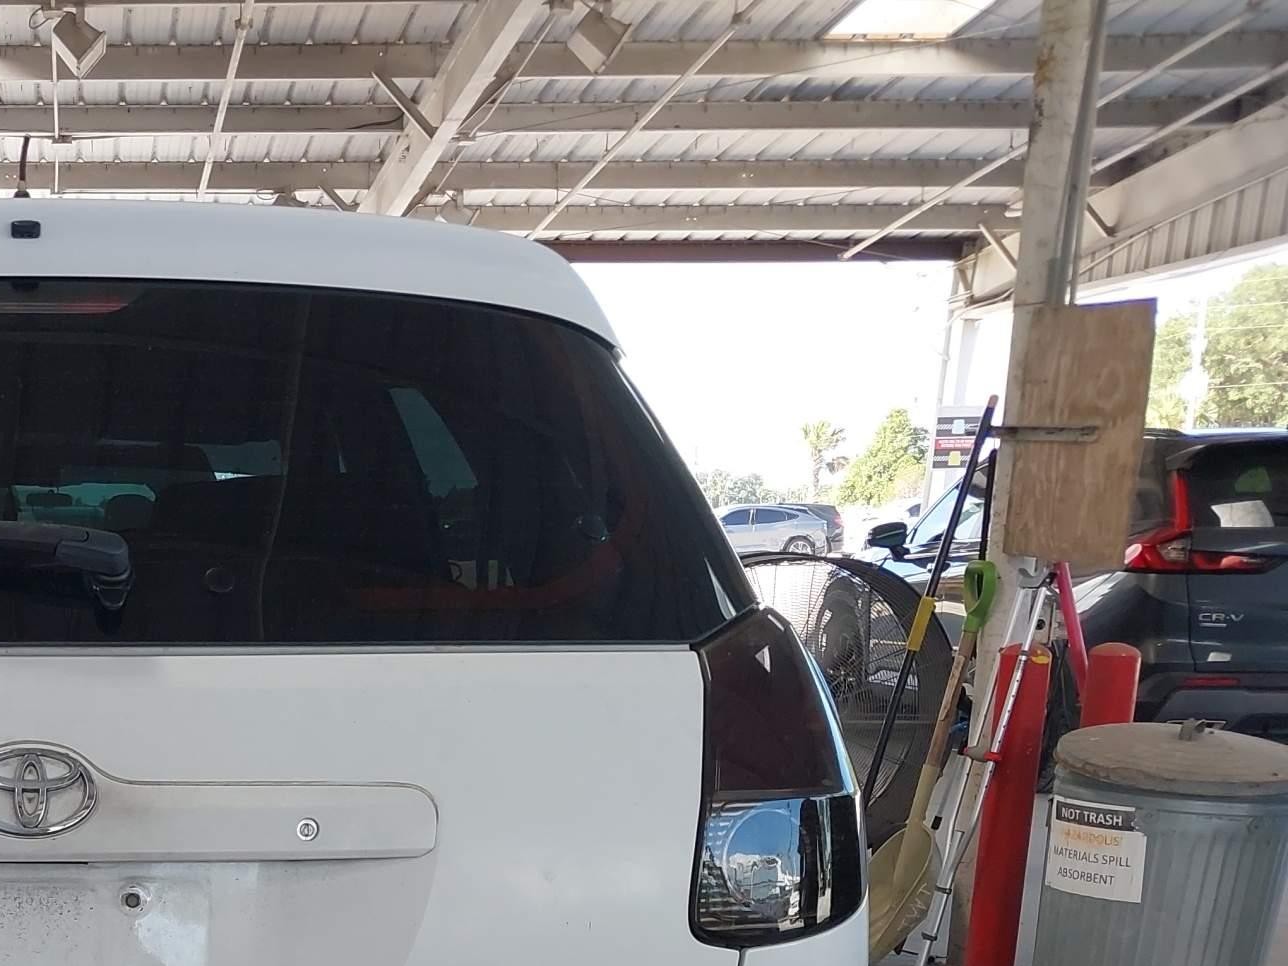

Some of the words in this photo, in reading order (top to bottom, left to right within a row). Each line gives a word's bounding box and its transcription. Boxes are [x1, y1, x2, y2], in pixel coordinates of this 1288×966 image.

[1061, 807, 1081, 820] NOT
[1083, 811, 1123, 827] TRASH
[1053, 844, 1099, 864] MATERIALS
[1101, 855, 1131, 868] SPILL
[1057, 866, 1115, 886] ABSORBENT
